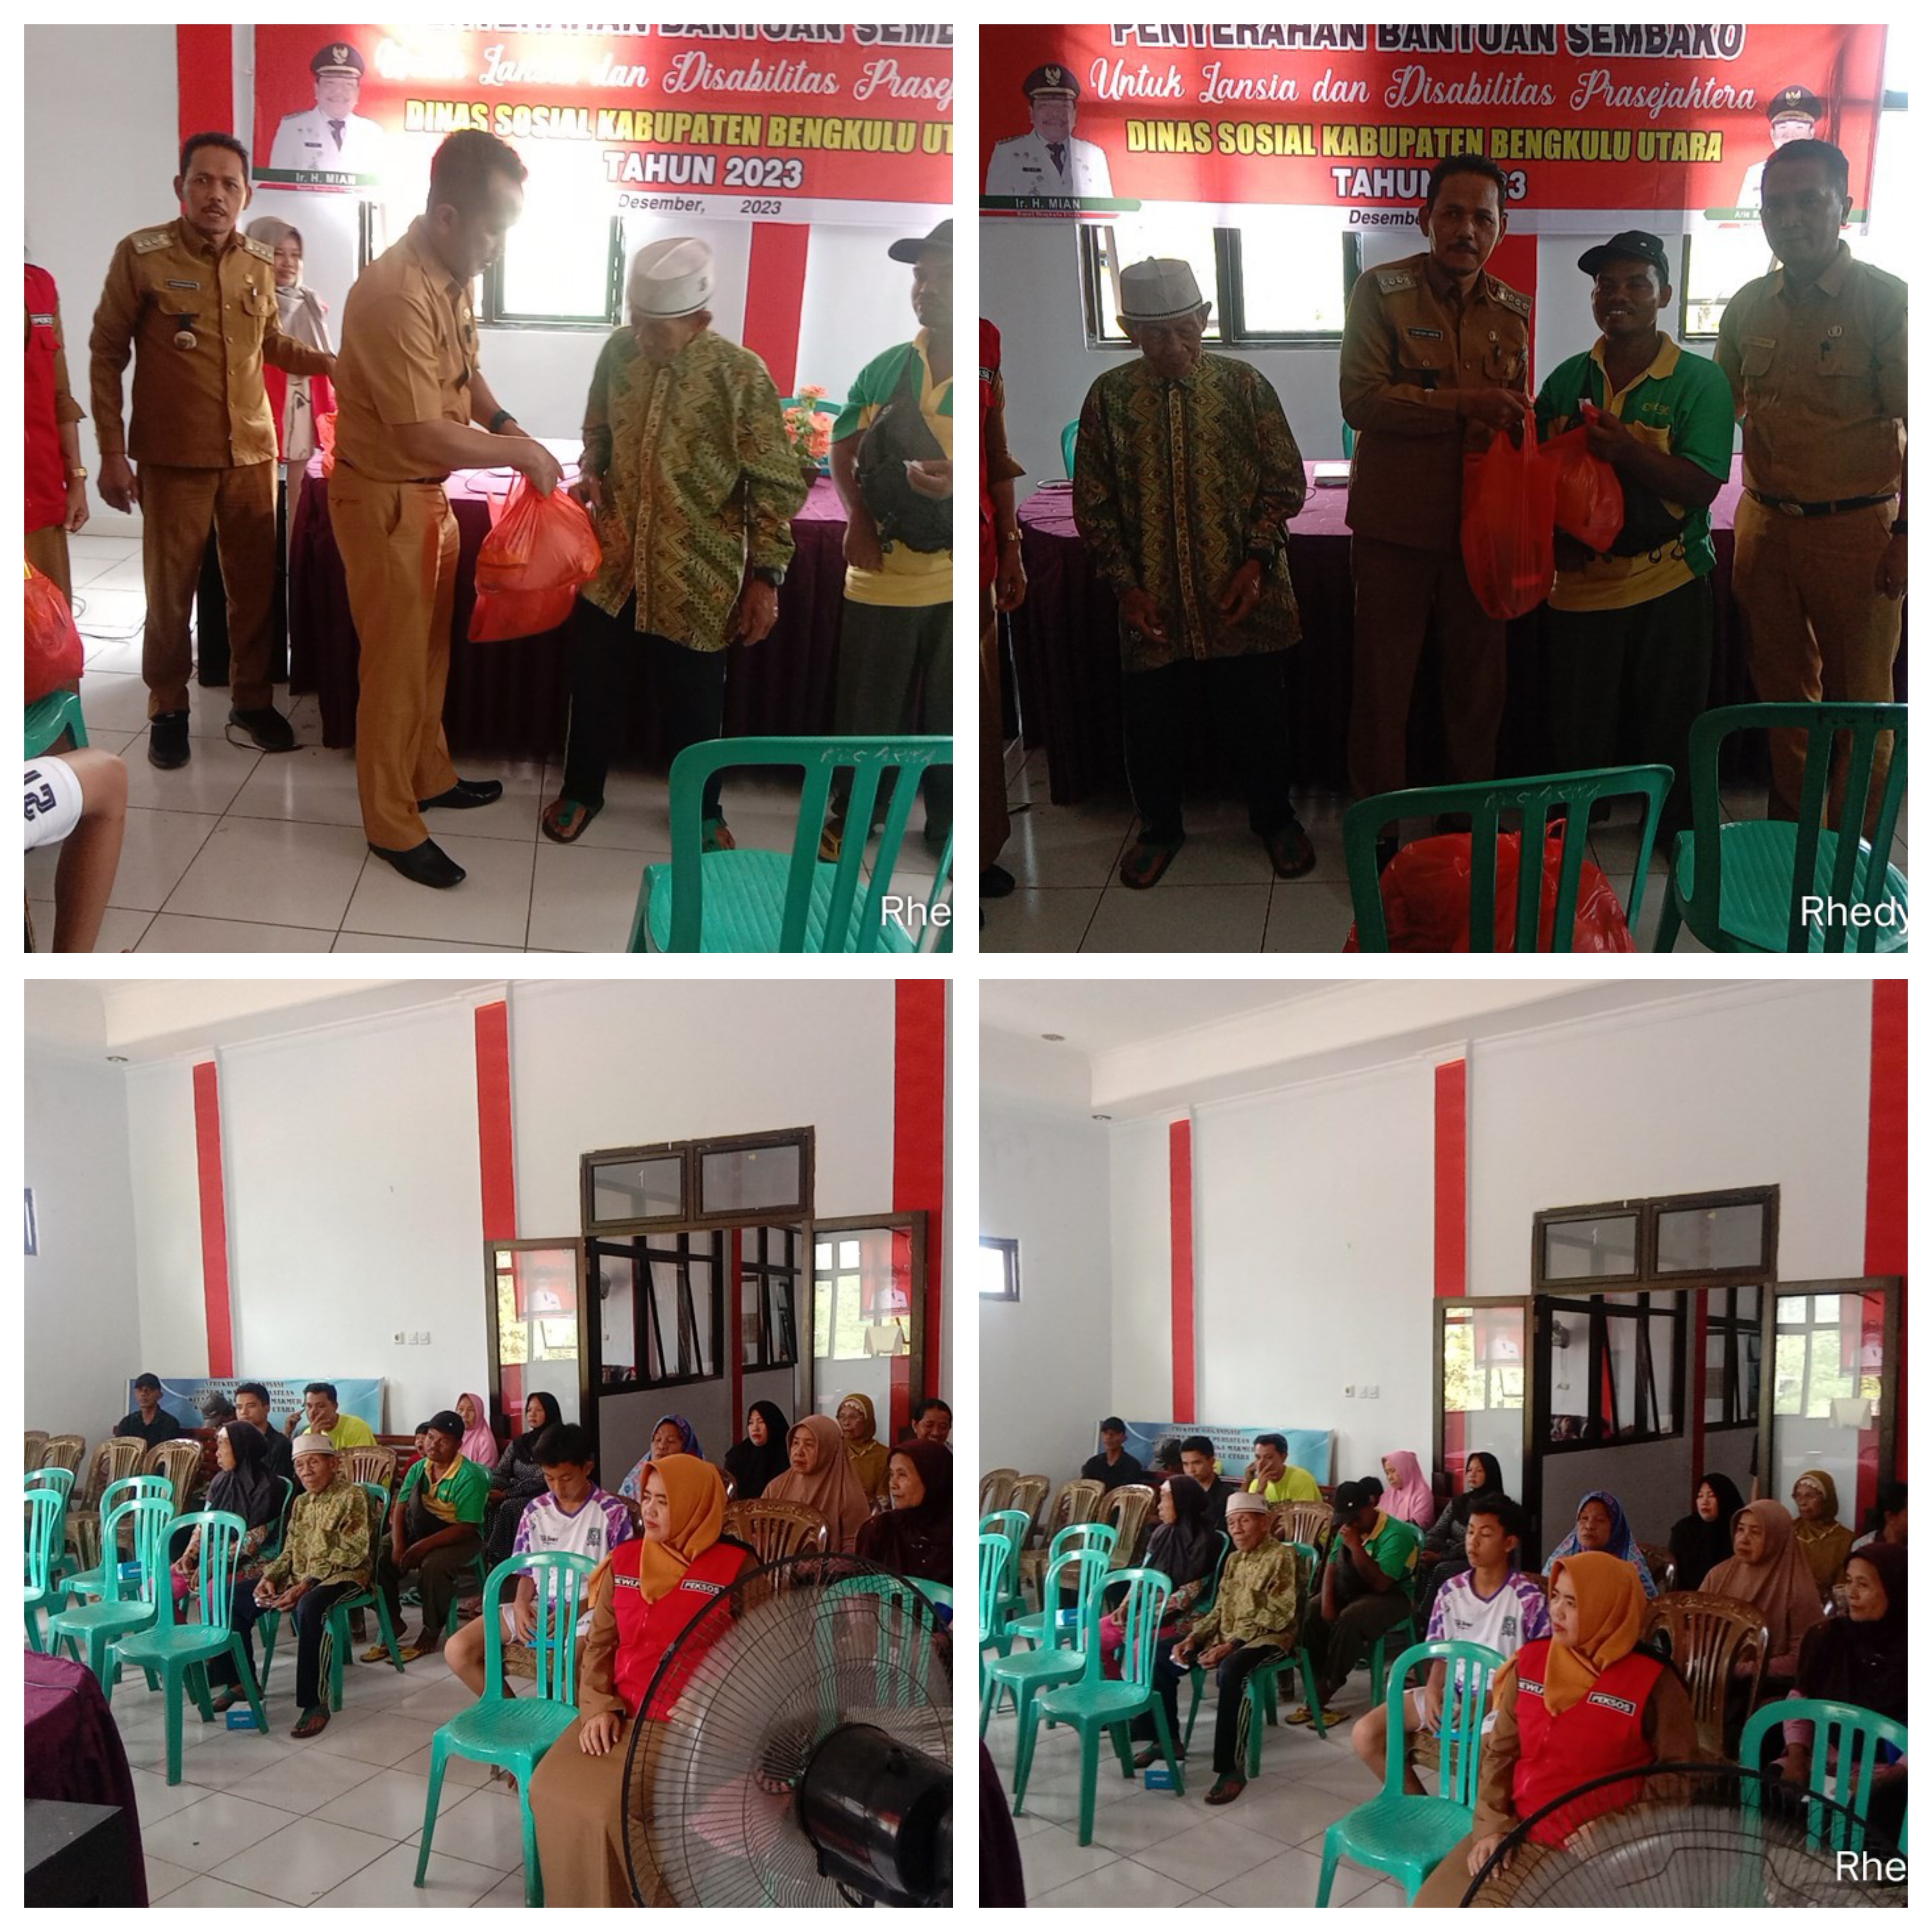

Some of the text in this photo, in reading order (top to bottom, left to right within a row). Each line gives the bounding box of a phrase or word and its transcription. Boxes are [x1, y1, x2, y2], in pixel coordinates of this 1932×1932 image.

[1375, 24, 1557, 55] BANTUAN
[1566, 24, 1745, 59] SEMBAKO
[662, 50, 841, 94] Disabilitas
[1090, 57, 1757, 119] Untuk Lansia dan Disabilitas Prasejahtera
[404, 99, 490, 134] DINAS
[493, 104, 591, 141] SOSIAL
[596, 108, 762, 147] KABUPATEN
[766, 115, 918, 154] BENGKULU
[1126, 120, 1724, 163] DINAS SOSIAL KABUPATEN BENGKULU UTARA
[602, 151, 804, 189] TAHUN 2023
[618, 194, 782, 215] Desember, 2023
[1048, 198, 1081, 209] MIAN
[1349, 209, 1420, 225] Desemb
[684, 1582, 720, 1594] PEKSOS
[1591, 1694, 1631, 1712] PEKSOS
